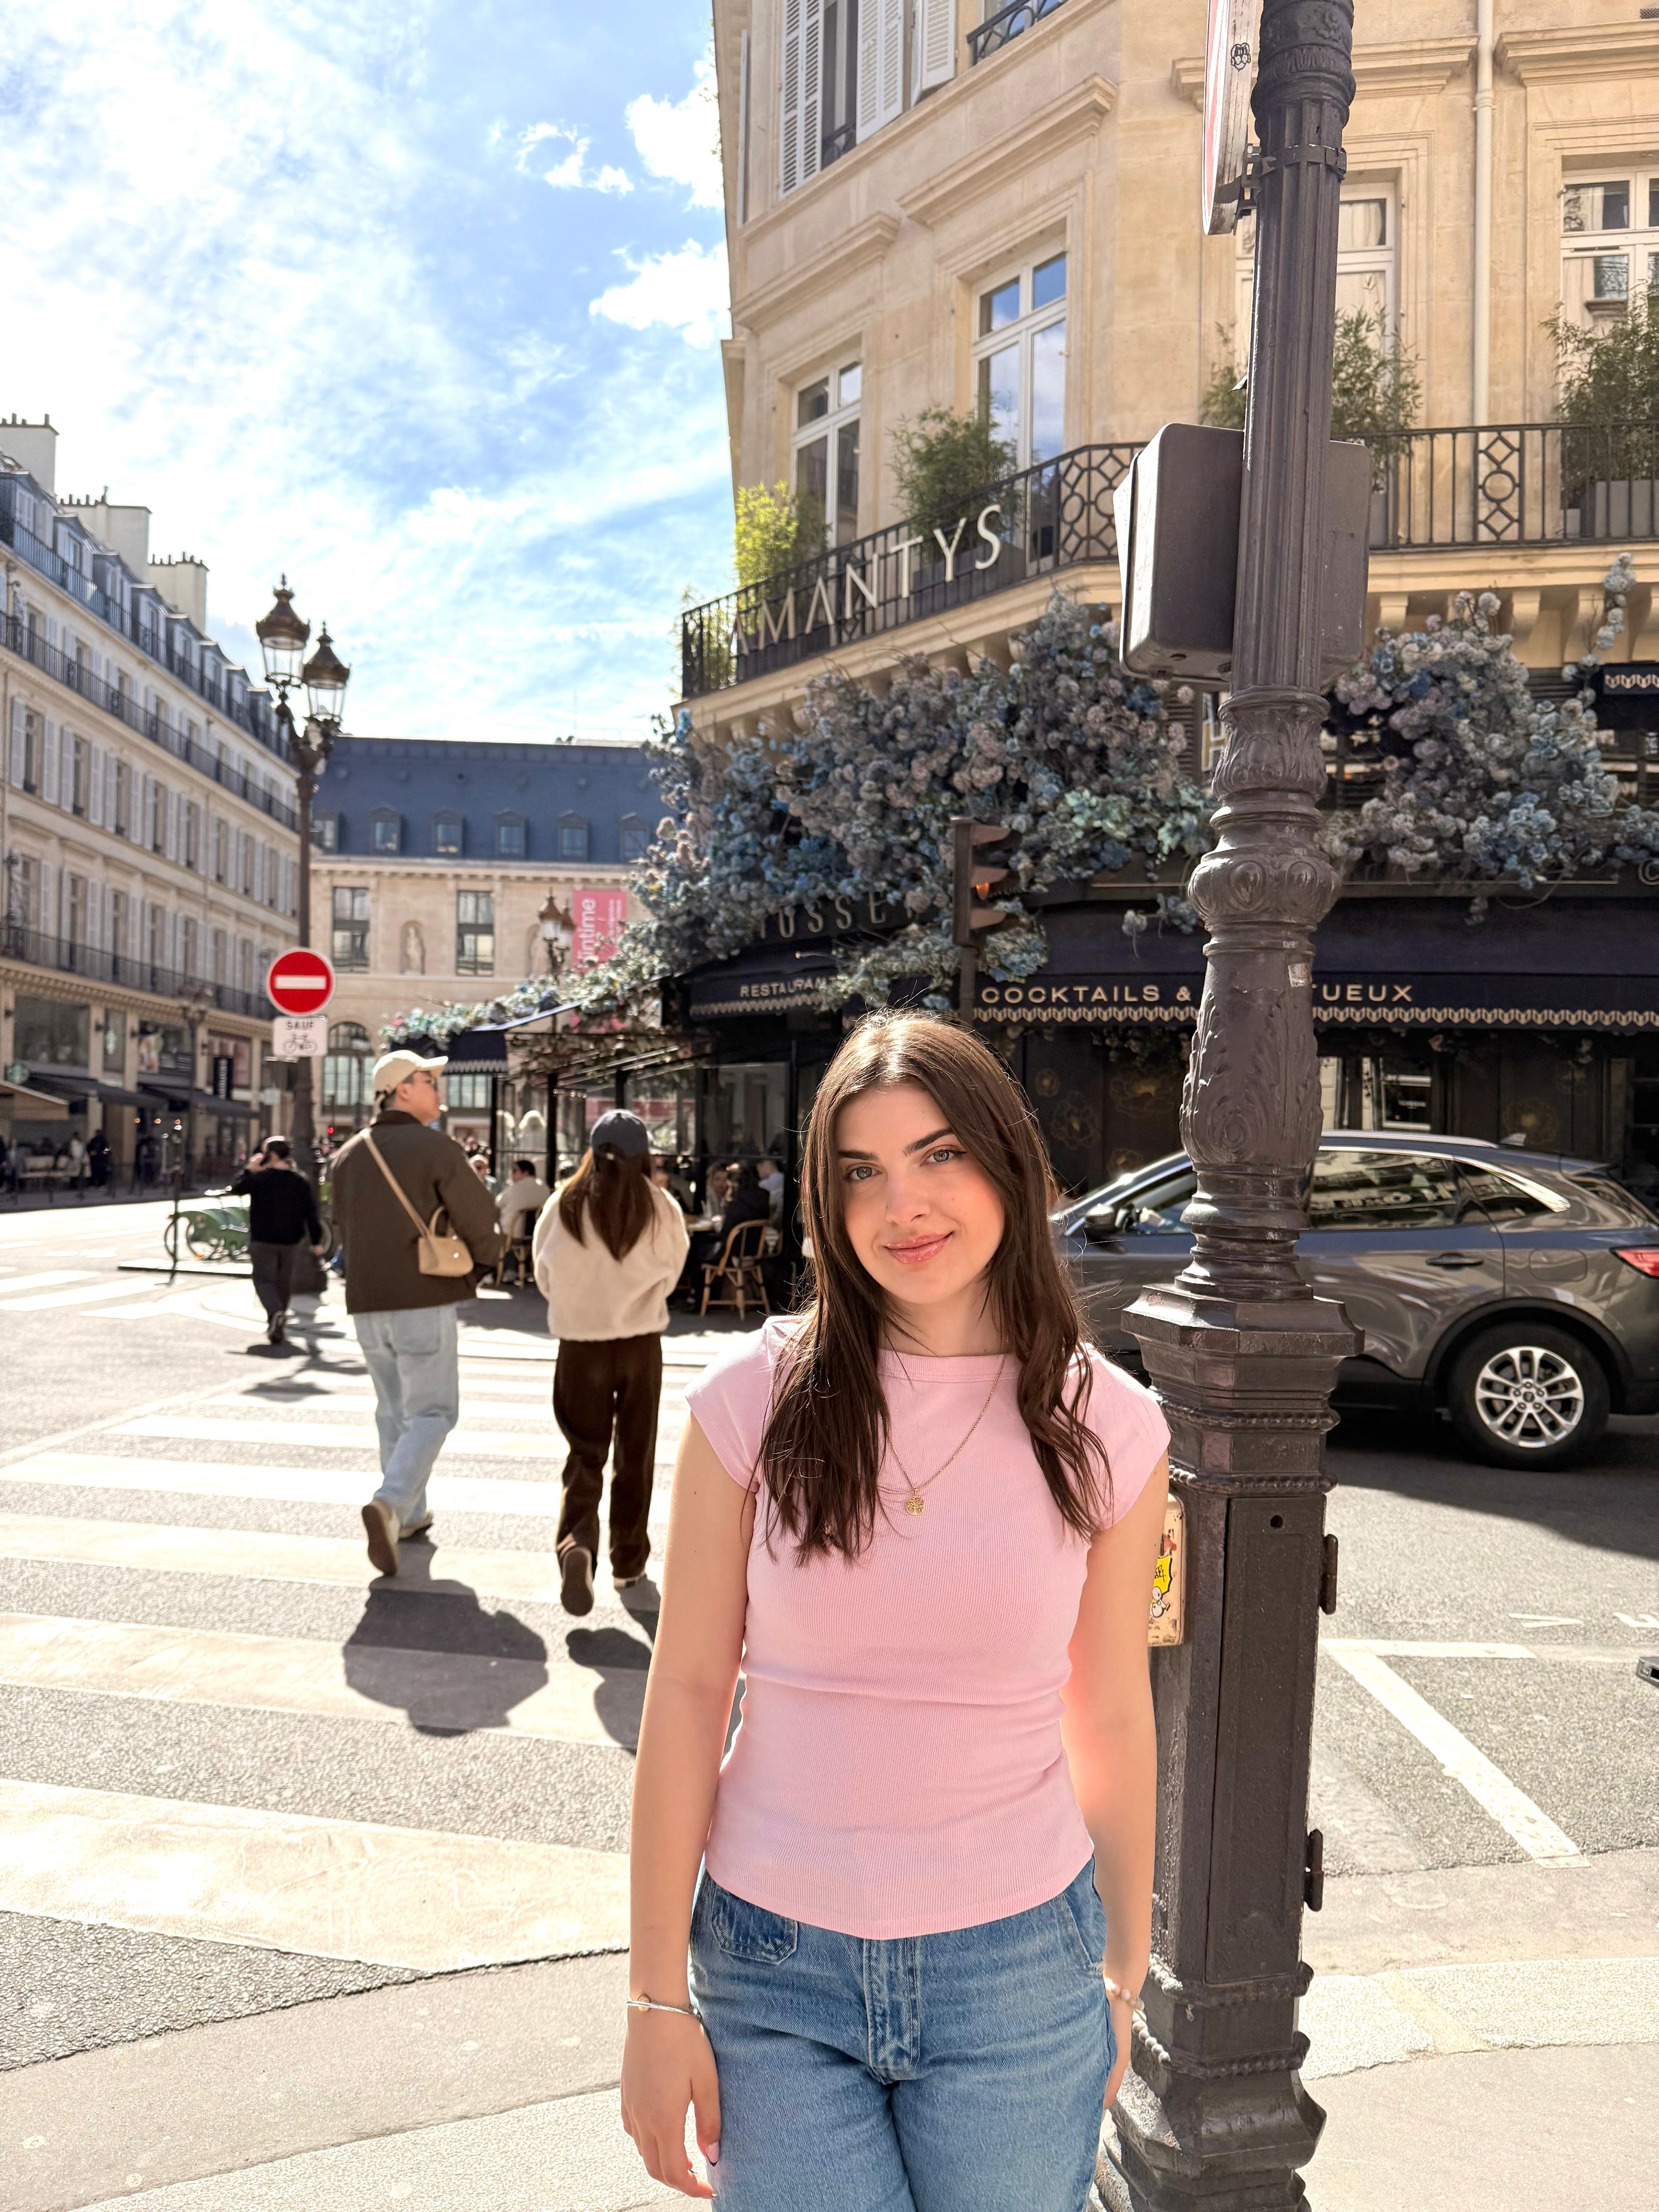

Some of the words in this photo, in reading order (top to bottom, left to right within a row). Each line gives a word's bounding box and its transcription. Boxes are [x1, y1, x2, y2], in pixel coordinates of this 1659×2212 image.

[730, 504, 1001, 656] AMANTYS
[760, 889, 912, 939] USSE
[740, 976, 836, 998] RESTAURAN
[981, 984, 1160, 1003] COCKTAILS
[1176, 985, 1191, 1002] &
[1312, 984, 1413, 1002] UEUX
[286, 1021, 314, 1030] SAUF
